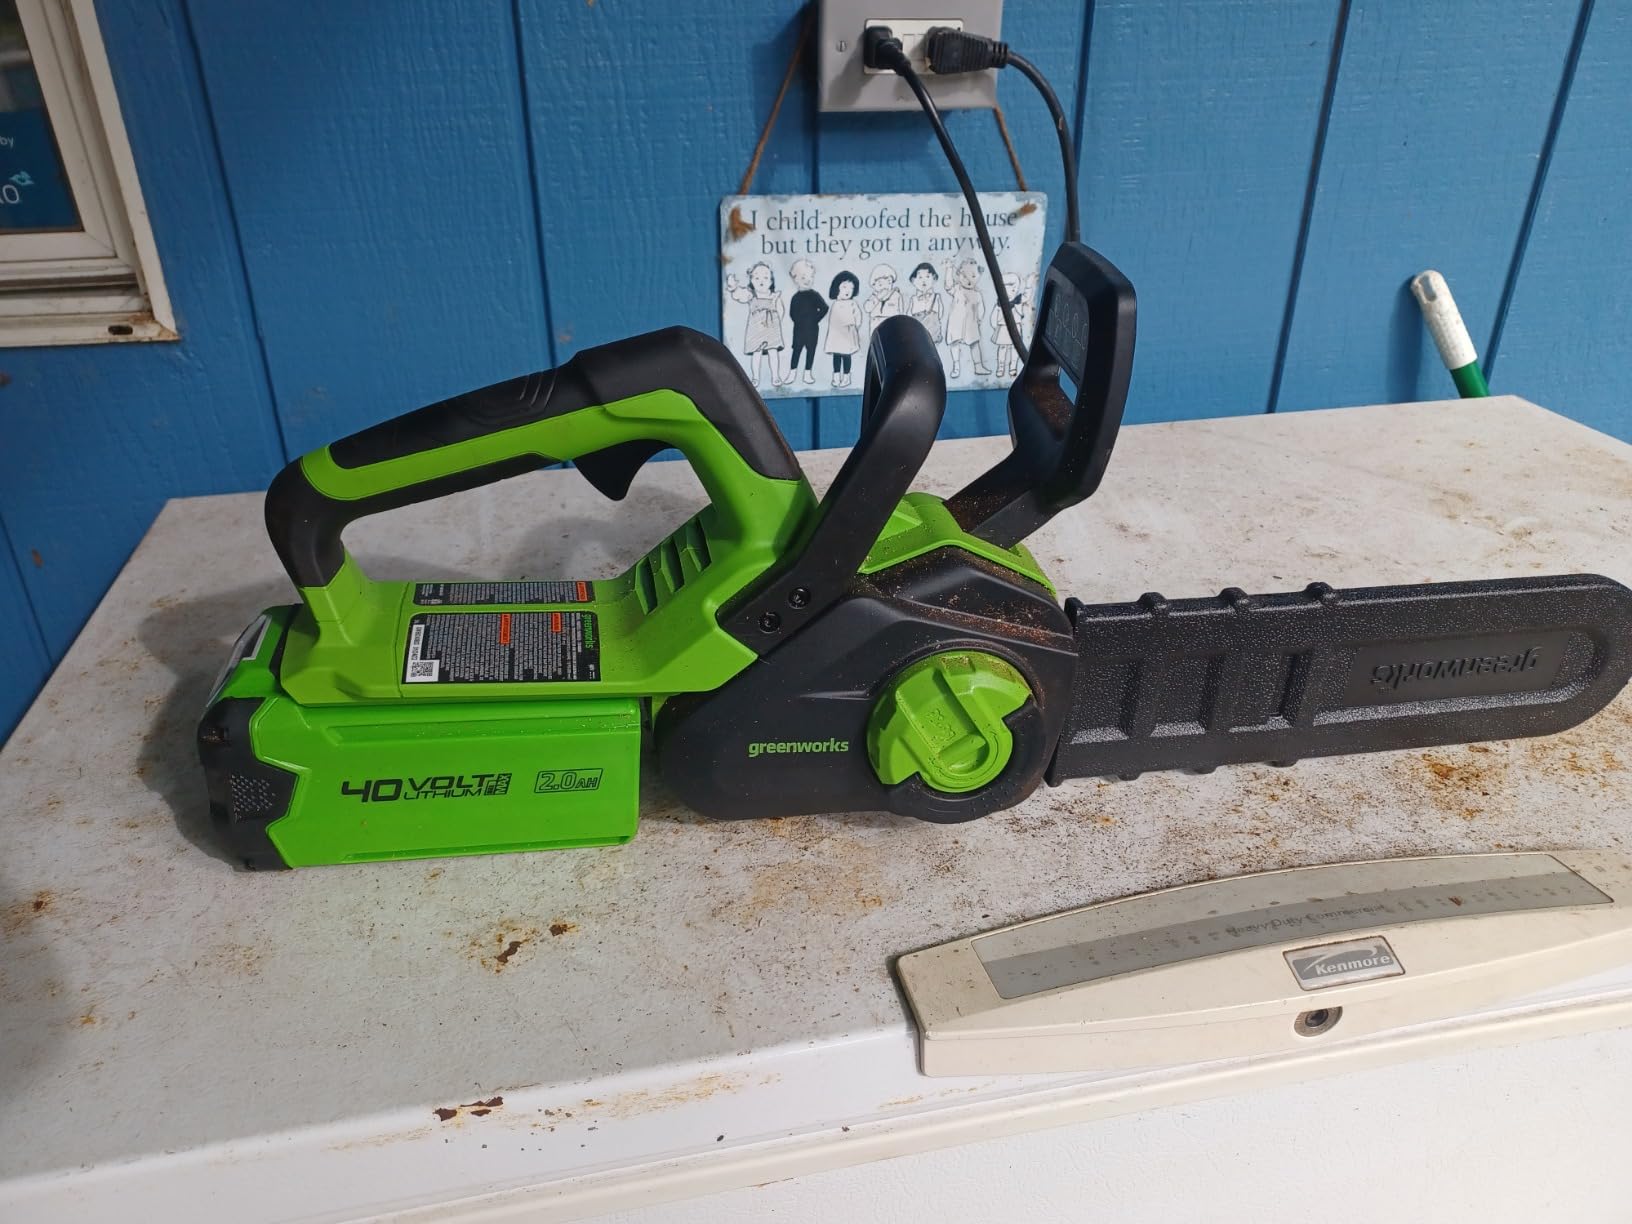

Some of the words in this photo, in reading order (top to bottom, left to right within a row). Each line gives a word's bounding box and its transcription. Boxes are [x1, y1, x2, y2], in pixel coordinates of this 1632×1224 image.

[750, 209, 758, 232] I
[766, 207, 910, 237] child-proofed
[919, 207, 952, 228] the
[959, 206, 1018, 227] huse
[761, 233, 796, 255] but
[806, 233, 852, 260] they
[858, 237, 892, 261] got
[901, 232, 920, 252] in
[748, 737, 850, 758] greenworks
[341, 778, 403, 803] 40
[408, 773, 495, 792] VOLT
[403, 788, 483, 801] LITHIUM
[1315, 954, 1391, 976] Kenmore
